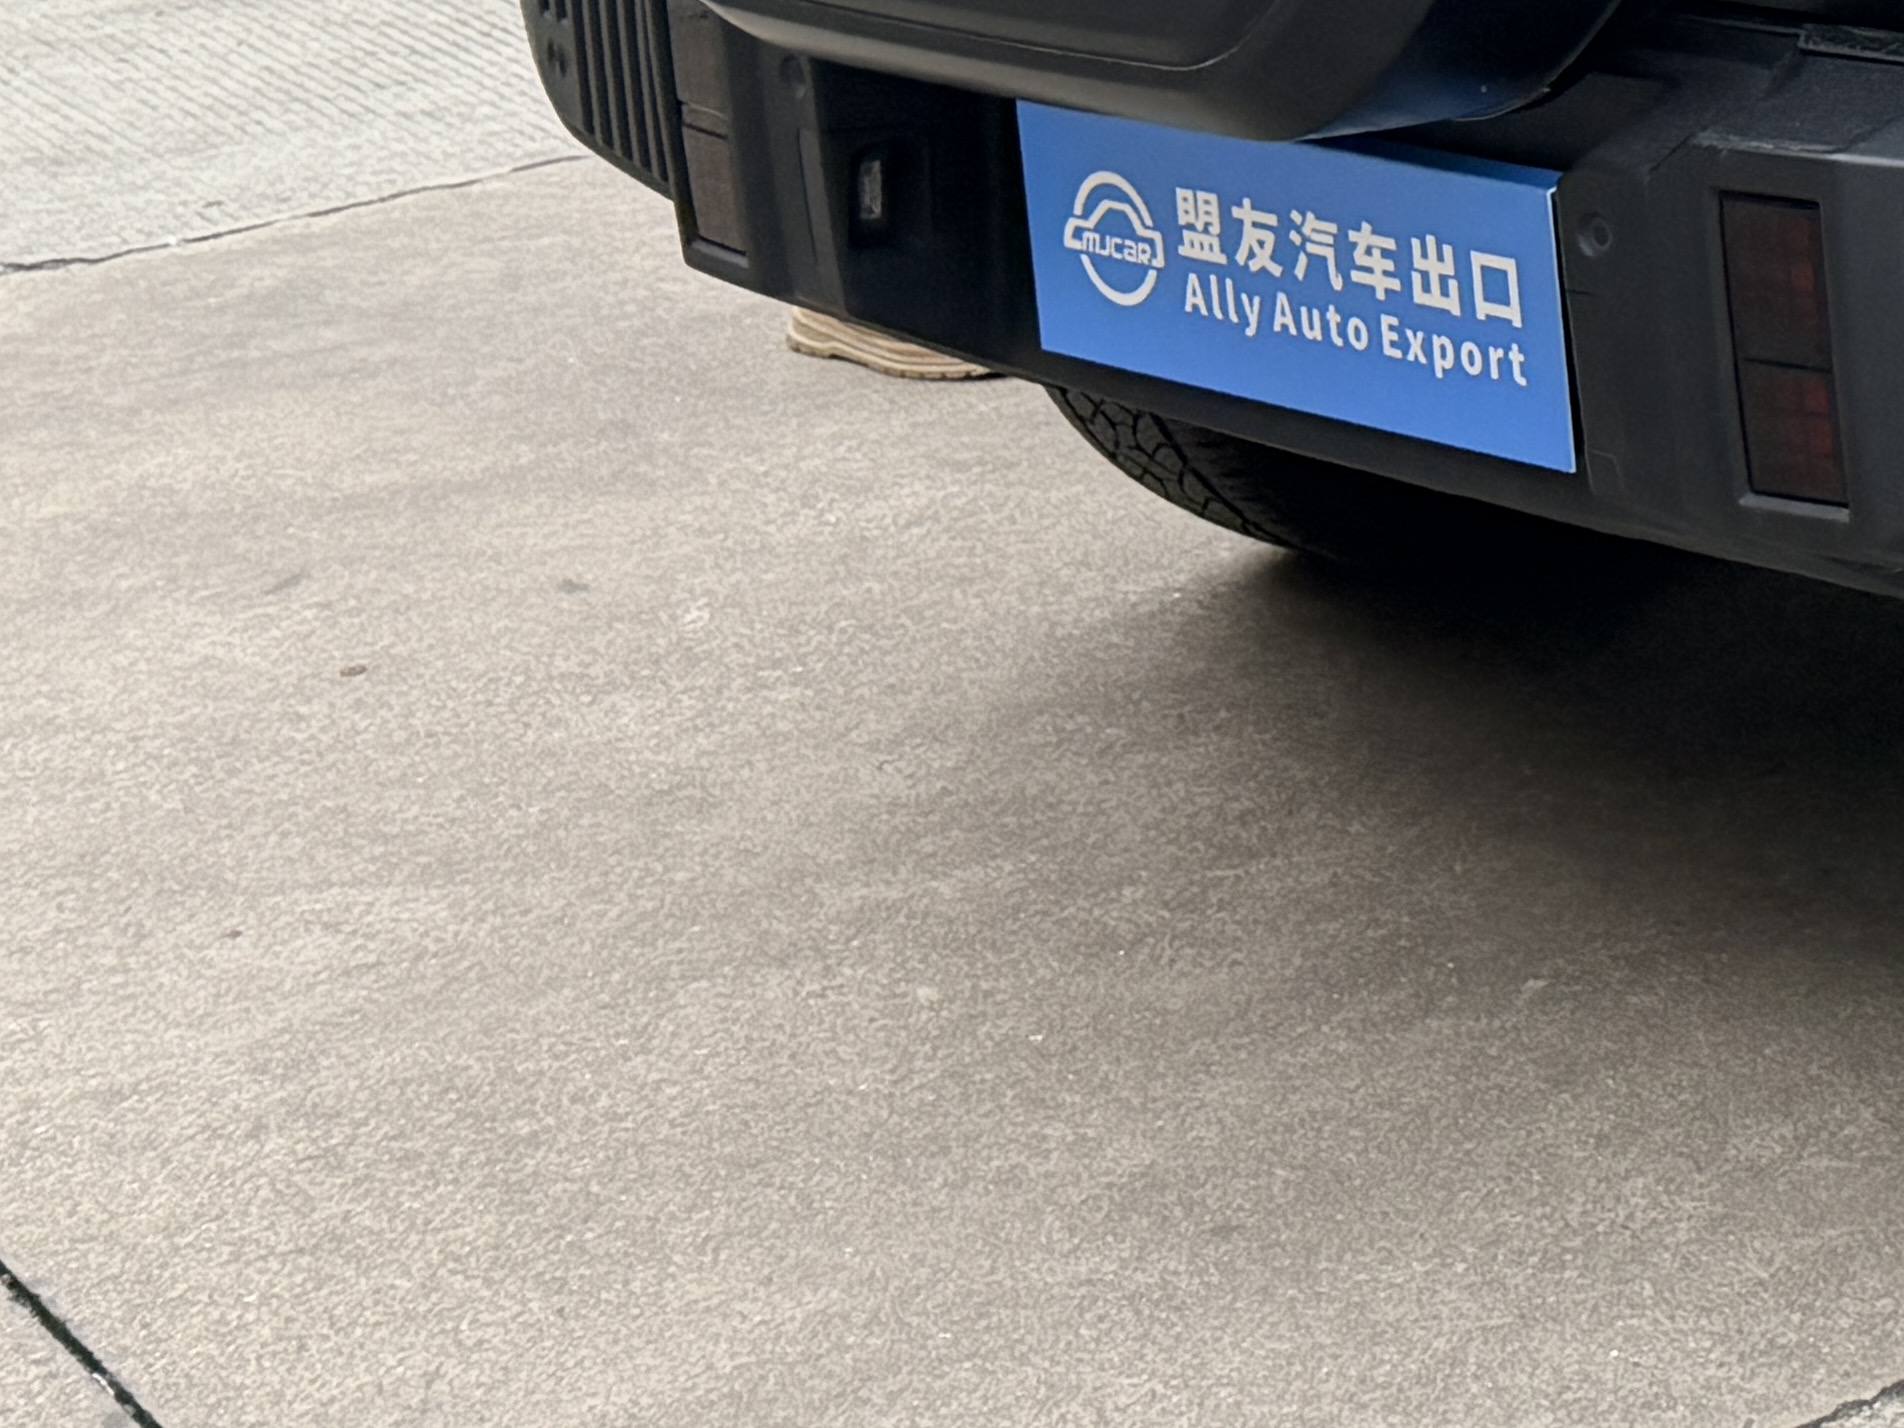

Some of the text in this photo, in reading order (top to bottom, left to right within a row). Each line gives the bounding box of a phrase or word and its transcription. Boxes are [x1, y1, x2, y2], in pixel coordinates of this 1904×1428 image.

[1176, 187, 1523, 328] 盟友汽车出口
[1184, 273, 1528, 386] Ally Auto Export
